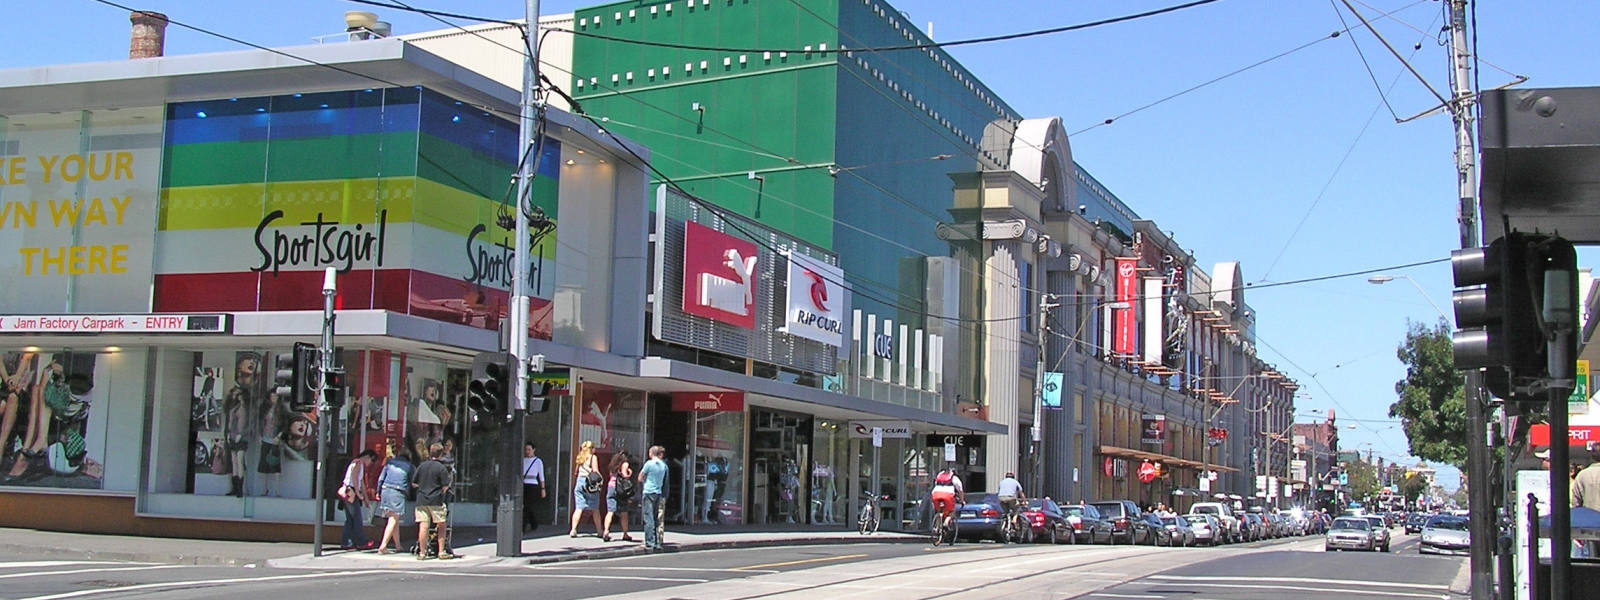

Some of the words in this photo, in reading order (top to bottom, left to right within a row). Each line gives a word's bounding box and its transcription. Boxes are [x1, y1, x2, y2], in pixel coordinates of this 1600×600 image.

[38, 151, 134, 184] YOUR
[49, 196, 132, 228] WAY
[251, 209, 387, 277] Sportsgirl
[19, 244, 129, 276] THERE
[463, 224, 543, 296] Sportsrl
[14, 317, 36, 328] Jam
[40, 317, 78, 331] Factory
[82, 317, 124, 331] Carpark
[146, 317, 184, 328] ENTRY
[797, 309, 818, 329] RIP
[818, 316, 844, 334] CURL
[875, 335, 892, 362] CUE
[944, 436, 964, 446] CUE
